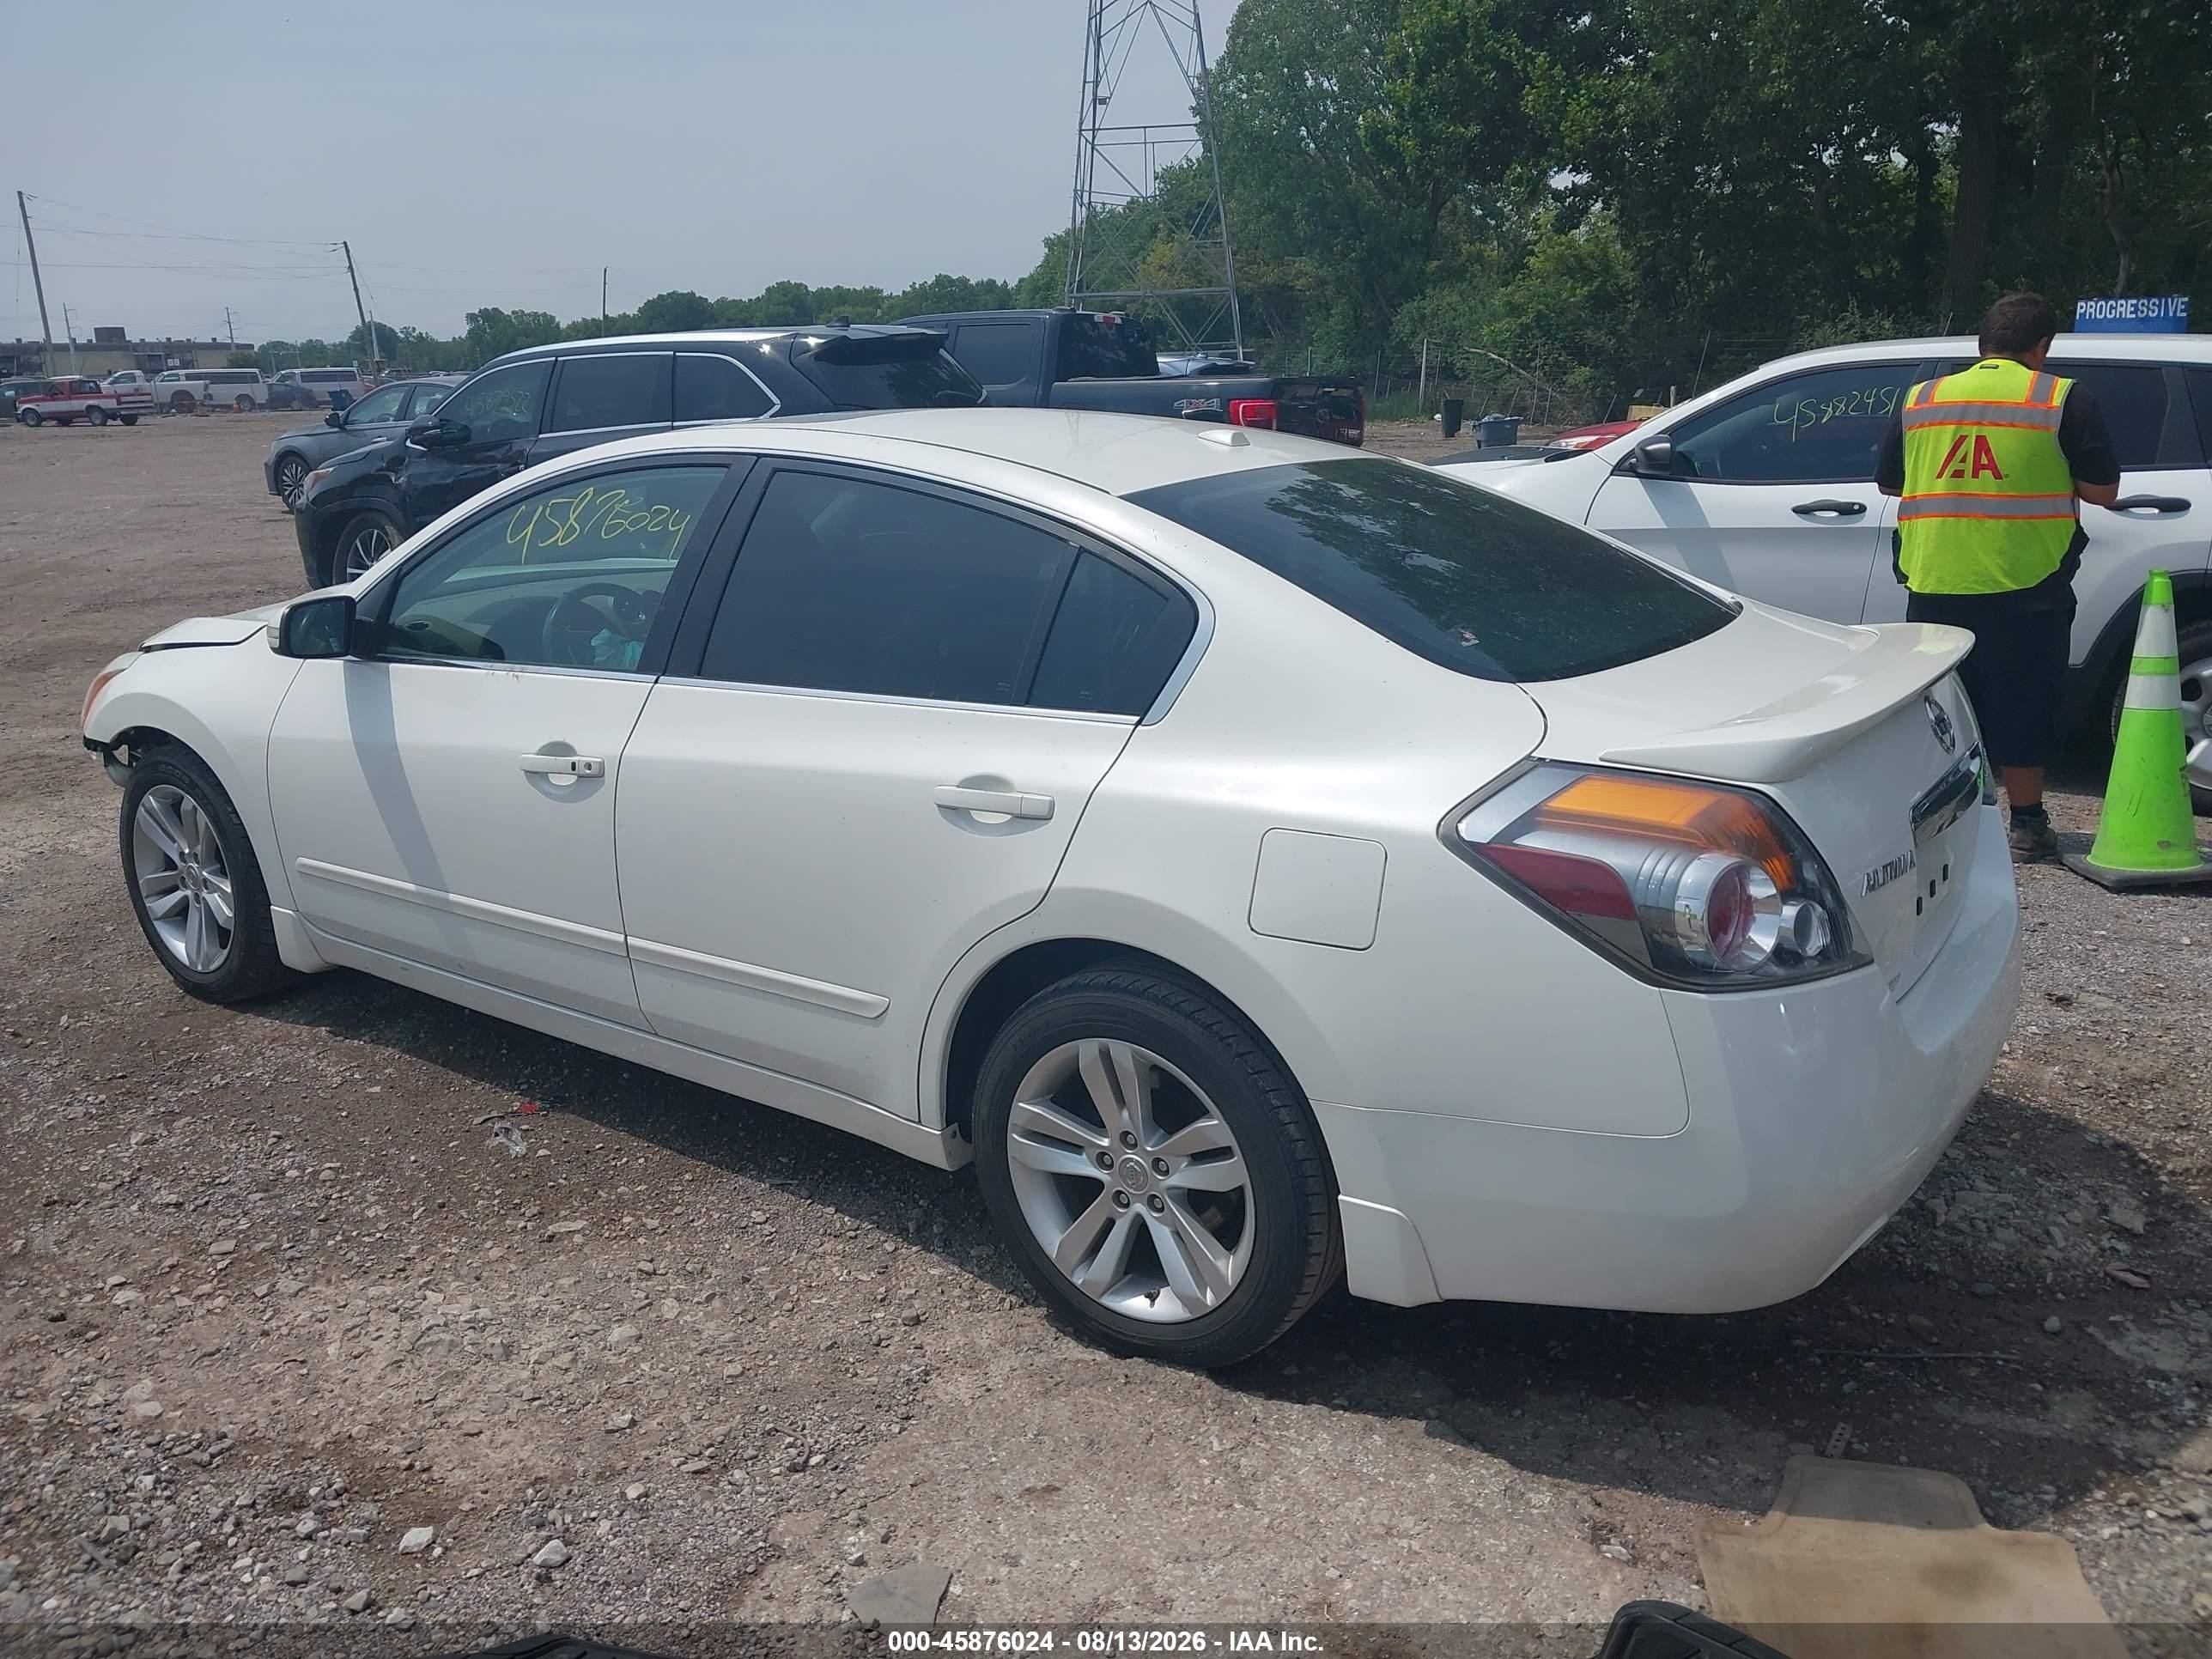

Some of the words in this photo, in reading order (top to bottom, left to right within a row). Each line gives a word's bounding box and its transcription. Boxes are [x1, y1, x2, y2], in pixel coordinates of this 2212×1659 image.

[2075, 297, 2189, 319] PROGRESSIVE
[1773, 386, 1900, 442] 45882451
[506, 486, 691, 564] 45876024
[1860, 848, 1917, 898] ALTIMA
